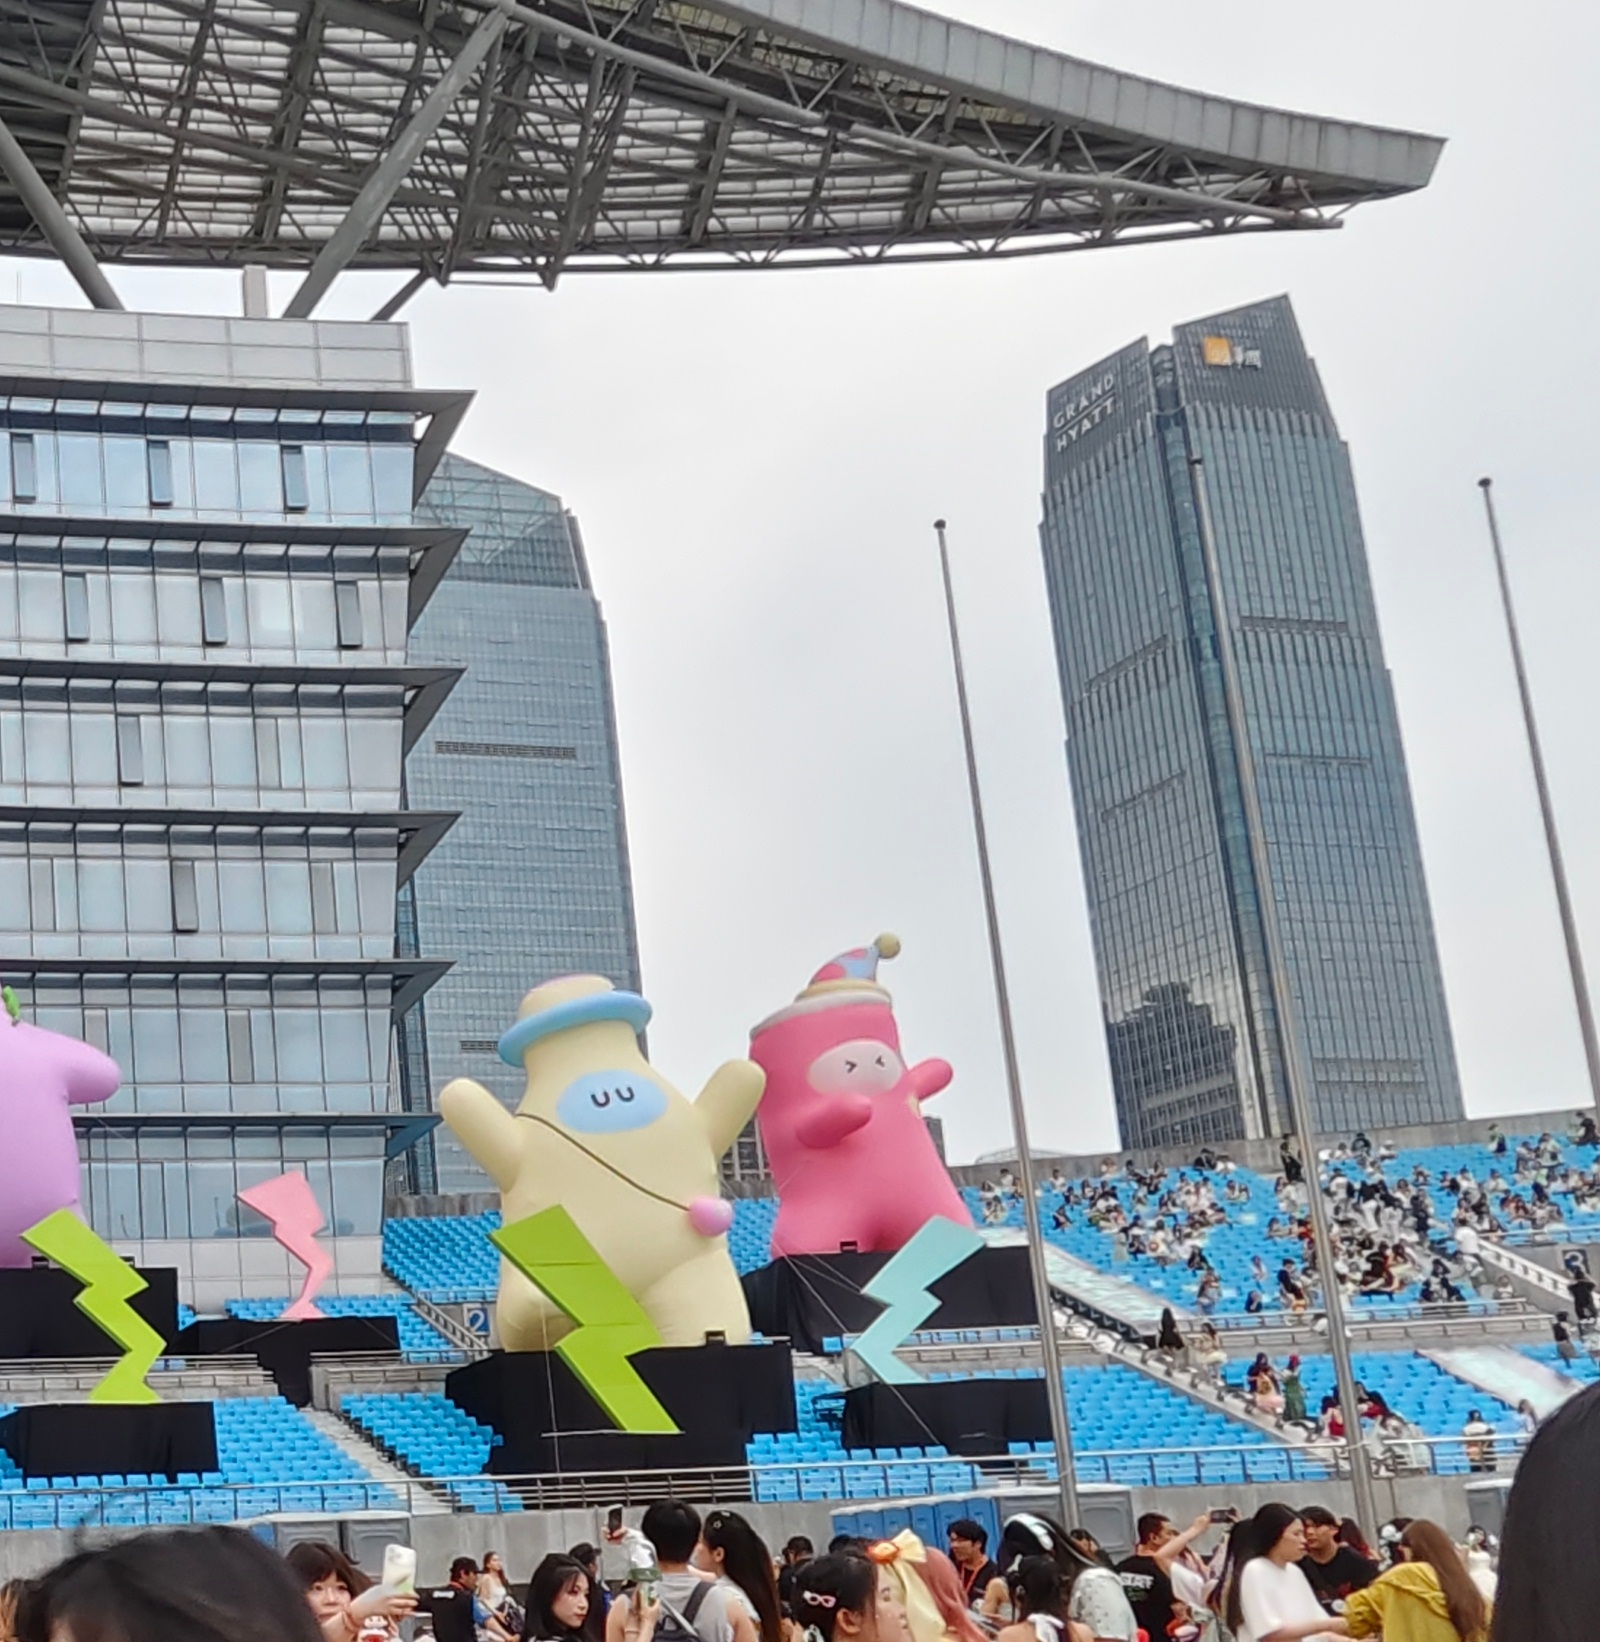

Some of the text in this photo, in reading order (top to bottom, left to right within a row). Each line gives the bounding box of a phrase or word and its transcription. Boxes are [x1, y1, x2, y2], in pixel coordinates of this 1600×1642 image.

[1054, 373, 1114, 428] GRAND
[1057, 396, 1114, 452] HYATT
[468, 1309, 487, 1336] 2
